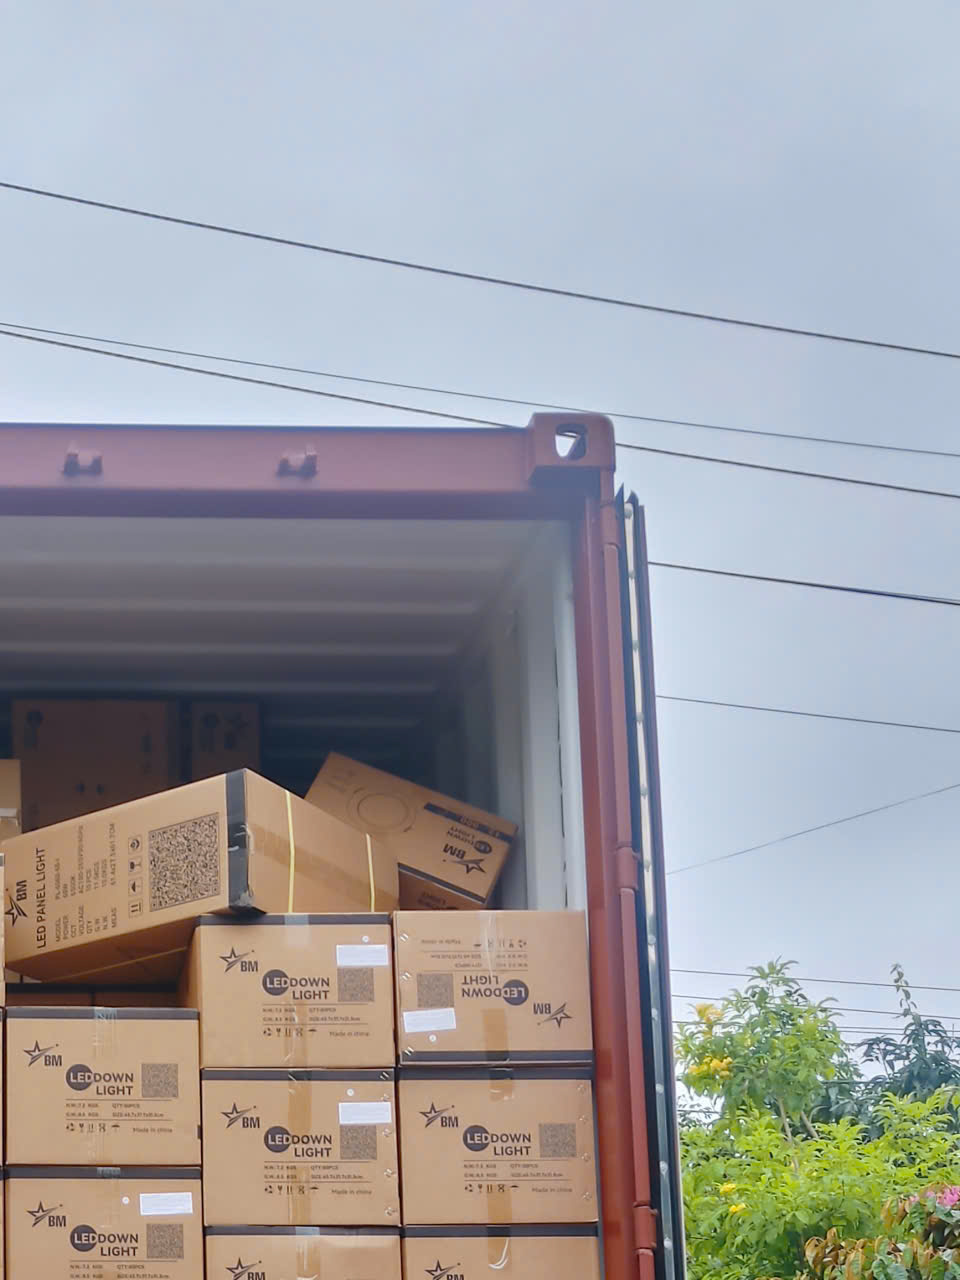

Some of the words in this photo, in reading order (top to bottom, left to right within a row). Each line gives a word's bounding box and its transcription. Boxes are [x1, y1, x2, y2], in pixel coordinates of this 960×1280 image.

[443, 843, 466, 859] BM
[35, 848, 45, 882] LIGHT
[16, 880, 27, 901] BM
[36, 884, 46, 922] PANEL
[36, 925, 47, 949] LED
[240, 961, 258, 972] BM
[461, 975, 499, 985] LIGHT
[292, 990, 330, 1000] LIGHT
[533, 1003, 551, 1015] BM
[44, 1055, 62, 1066] BM
[96, 1085, 133, 1096] LIGHT
[242, 1116, 260, 1129] BM
[439, 1116, 458, 1128] BM
[294, 1147, 332, 1158] LIGHT
[492, 1146, 531, 1156] LIGHT
[48, 1215, 66, 1227] BM
[100, 1246, 139, 1257] LIGHT
